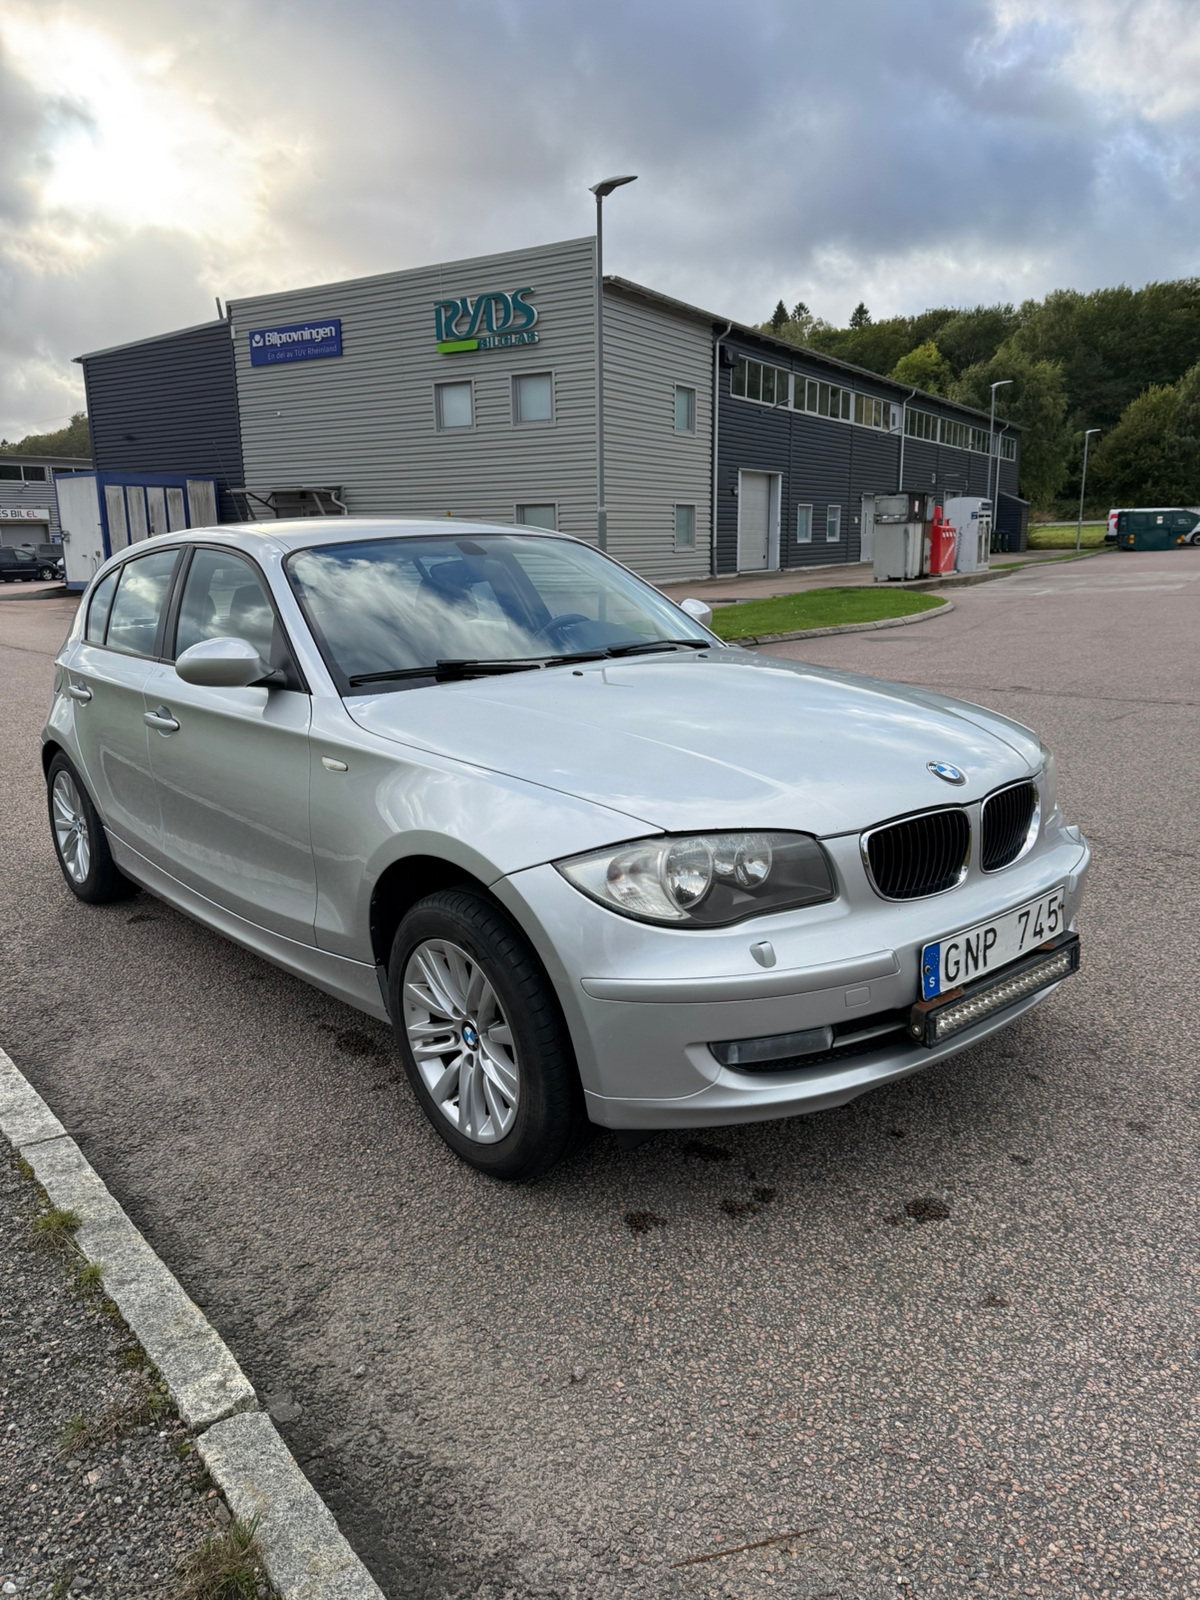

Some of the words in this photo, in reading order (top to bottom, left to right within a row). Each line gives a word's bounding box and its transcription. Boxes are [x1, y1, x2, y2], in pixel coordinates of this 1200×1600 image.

[434, 287, 538, 342] RYDS
[265, 326, 336, 347] Bilprovningen
[276, 351, 286, 359] del
[307, 345, 337, 354] Rheinland
[0, 510, 9, 518] S
[10, 510, 25, 518] BIL
[26, 510, 37, 518] EL
[929, 976, 936, 988] S
[945, 927, 998, 982] GNP
[1018, 895, 1059, 951] 745
